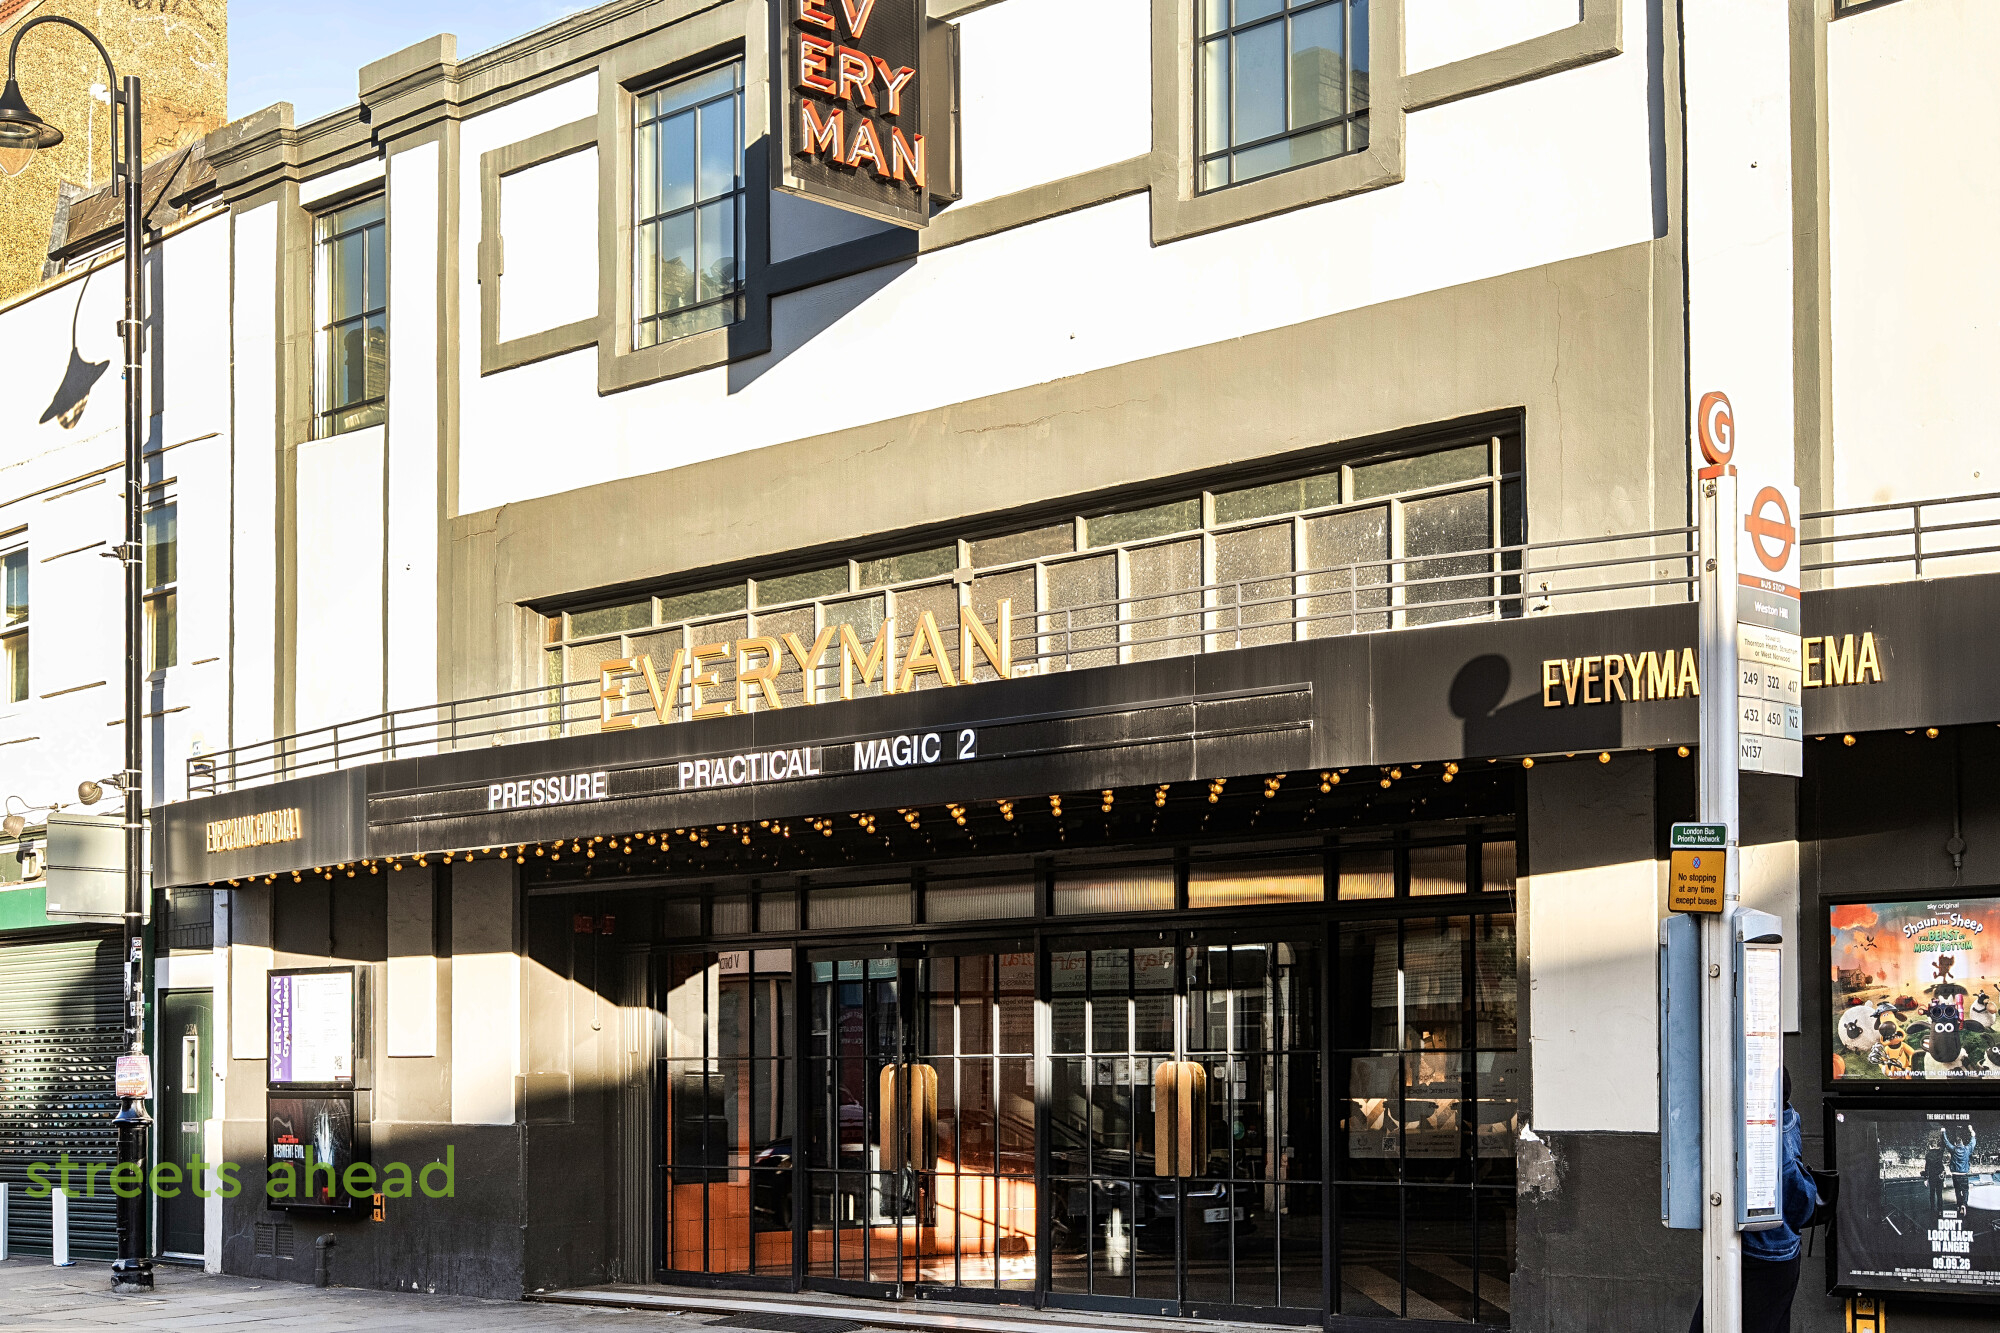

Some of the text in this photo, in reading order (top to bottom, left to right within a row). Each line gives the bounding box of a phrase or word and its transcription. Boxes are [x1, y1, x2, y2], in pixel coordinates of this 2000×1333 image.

[800, 33, 916, 116] ERY
[801, 98, 926, 188] MAN
[1708, 401, 1731, 454] G
[1761, 580, 1786, 592] BUS STOP
[1779, 606, 1789, 619] Hill
[1760, 651, 1772, 659] West
[1772, 652, 1790, 663] Norwood
[600, 598, 1011, 733] EVERYMAN
[1543, 632, 1881, 708] EVERYMA EMA
[1744, 671, 1798, 693] 249 322 417
[1744, 708, 1798, 728] 432 450 N2
[1741, 744, 1762, 758] N137
[488, 728, 976, 811] PRESSURE PRACTICAL MAGIC 2
[1683, 827, 1703, 835] London
[1678, 835, 1696, 844] Priority
[1678, 872, 1716, 883] No stopping
[1678, 884, 1714, 894] at any time
[1676, 896, 1718, 906] except buses
[1938, 902, 1960, 910] original
[1903, 918, 1938, 938] Shaun
[1950, 913, 1984, 936] Sheep
[1928, 928, 1960, 942] BEAST
[1914, 940, 1973, 954] MOSSY BOTTOM
[282, 977, 290, 1058] Crystal Palace
[273, 977, 282, 1080] EVERYMAN
[274, 1144, 305, 1158] RESIDENT EVIL
[1938, 1218, 1962, 1230] DON'T
[1928, 1230, 1974, 1242] LOOK BACK
[1932, 1240, 1970, 1252] IN ANGER
[1932, 1258, 1970, 1270] 09.09.26
